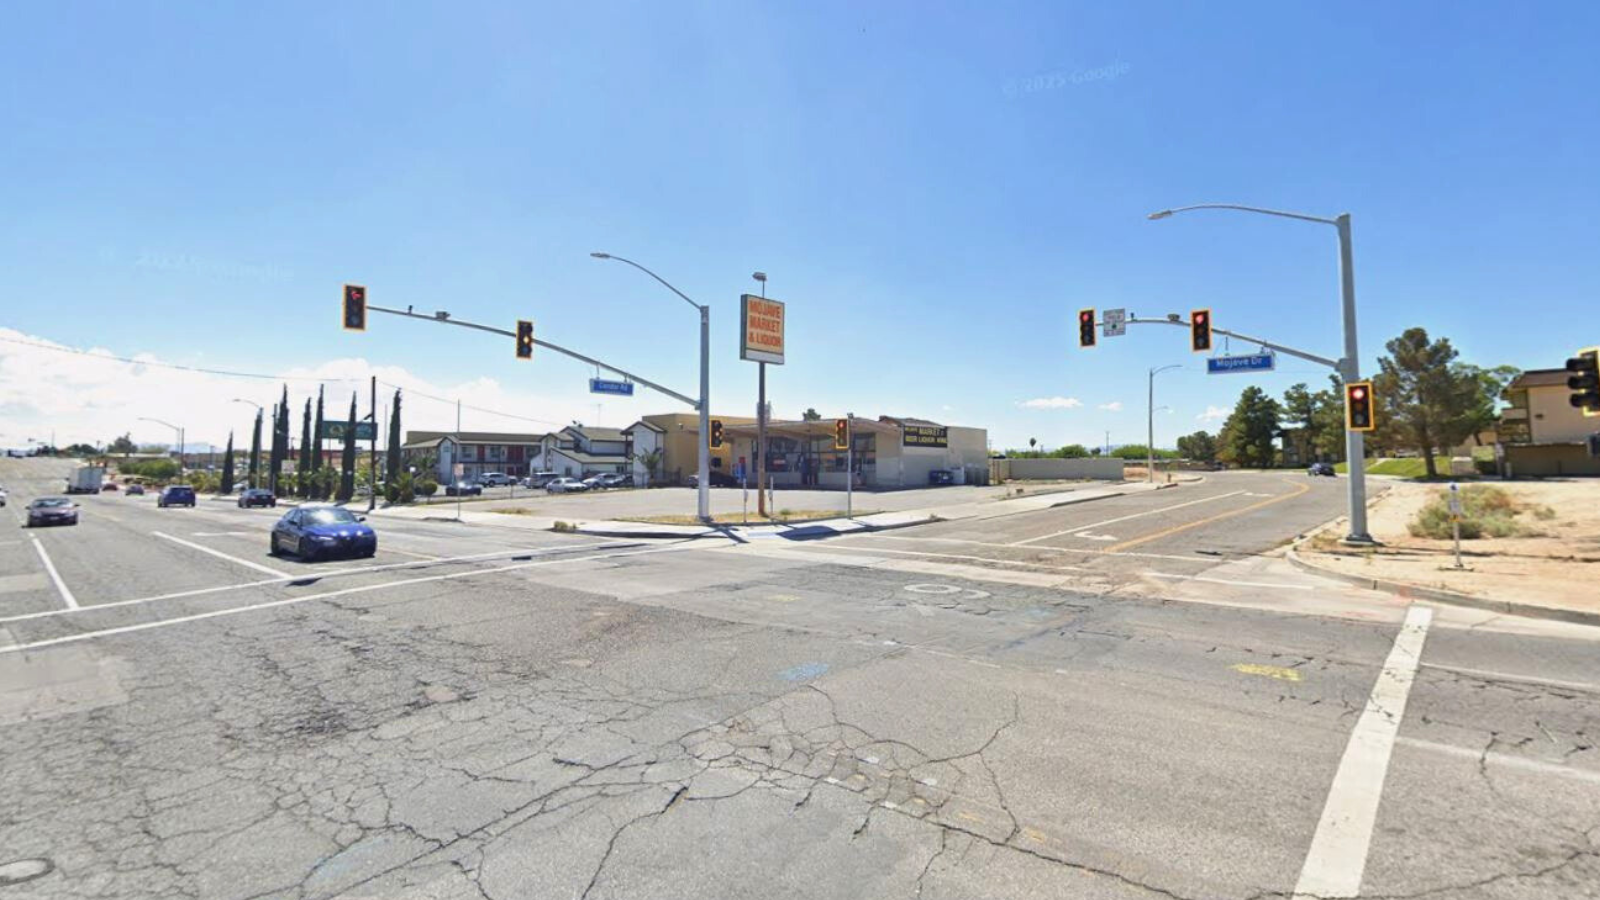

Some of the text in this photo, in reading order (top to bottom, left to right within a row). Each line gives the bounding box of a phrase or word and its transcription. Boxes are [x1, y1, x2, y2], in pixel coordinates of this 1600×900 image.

[749, 300, 781, 319] MOJAVE
[749, 314, 781, 333] MARKET
[756, 333, 781, 347] LIQUOR
[1216, 356, 1262, 369] Mojave Dr
